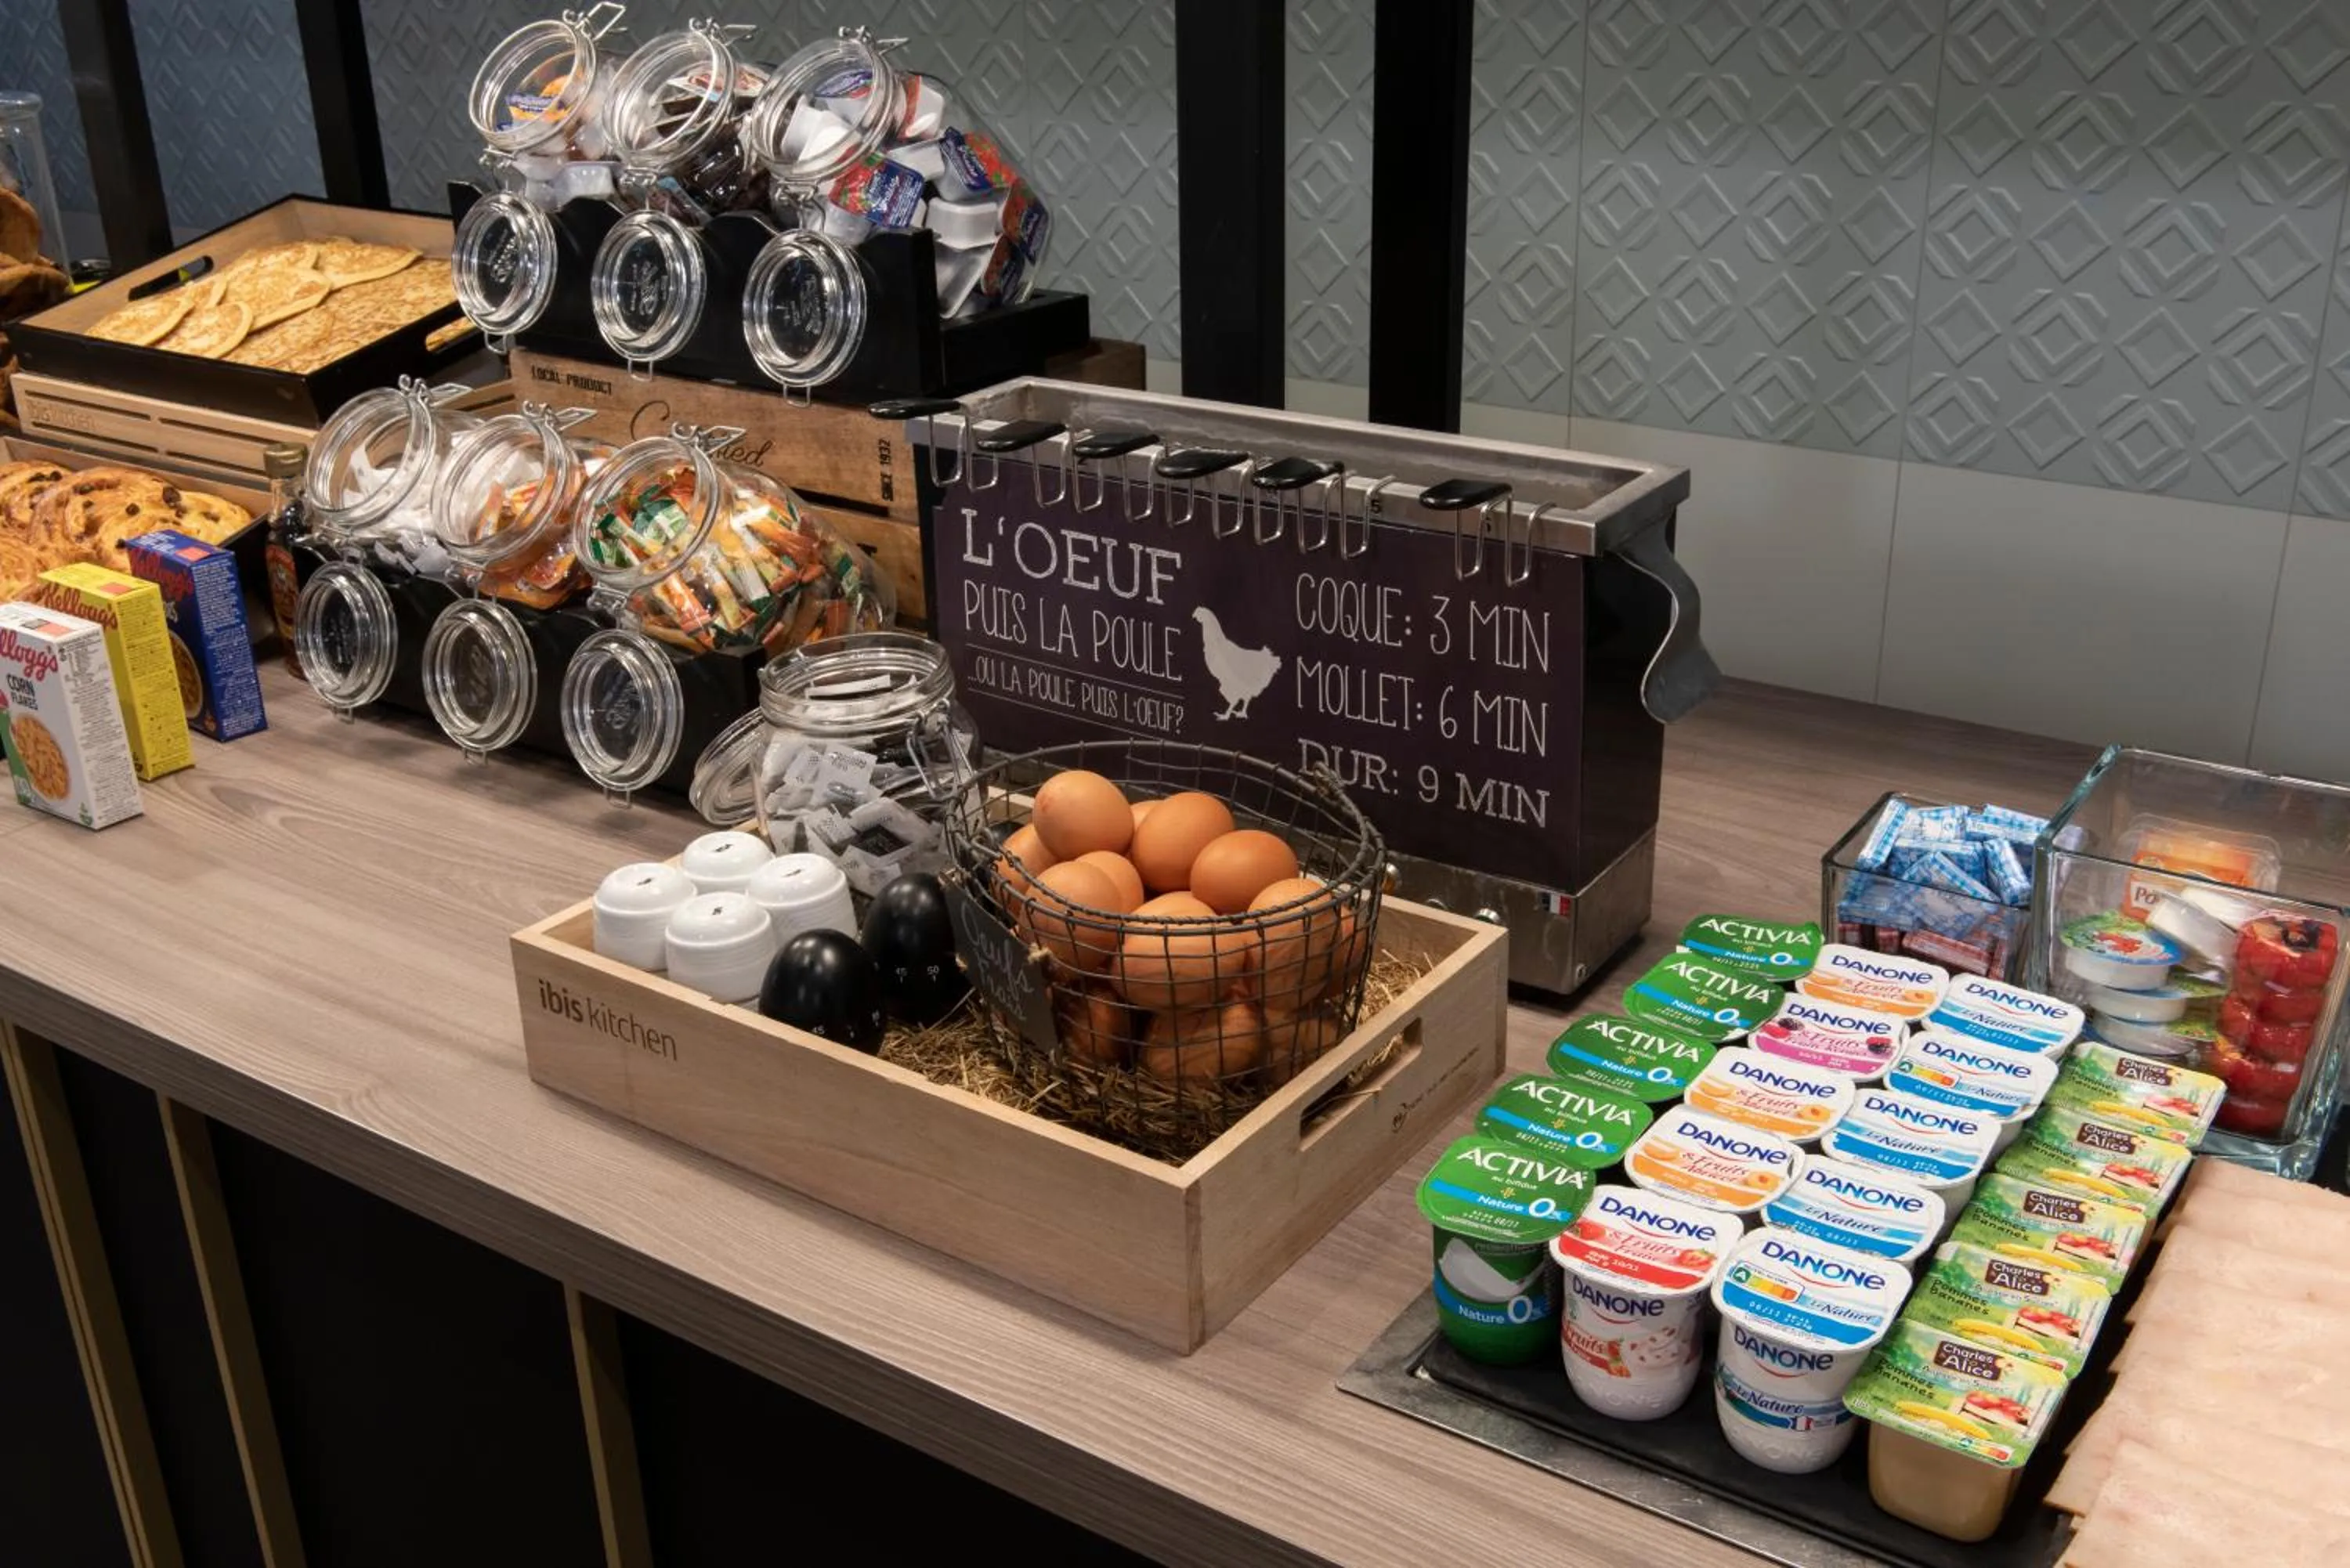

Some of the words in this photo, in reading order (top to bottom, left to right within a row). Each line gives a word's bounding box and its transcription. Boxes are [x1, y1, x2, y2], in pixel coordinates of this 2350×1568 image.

[961, 508, 1182, 605] L'OEUF
[964, 579, 1028, 645] PUIS
[1039, 597, 1079, 659] LA
[1093, 609, 1183, 682] POULE
[1296, 573, 1412, 648] COQUE:
[1430, 594, 1450, 655] 3
[1469, 600, 1550, 674] MIN
[1000, 661, 1023, 695] LA
[1028, 667, 1076, 708] POULE
[1081, 681, 1118, 719] PUIS
[1123, 692, 1184, 735] L'OEUF?
[1296, 655, 1423, 731] MOLLET:
[1439, 685, 1458, 739] 6
[1473, 689, 1549, 758] MIN
[1297, 737, 1400, 796] DUR:
[1417, 764, 1440, 804] 9
[1455, 771, 1550, 829] MIN
[1698, 918, 1811, 945] ACTIVIA
[1663, 961, 1772, 1004] ACTIVIA
[538, 978, 584, 1023] ibis
[587, 996, 678, 1062] kitchen
[1585, 1020, 1700, 1063] ACTIVIA
[1511, 1080, 1632, 1125] ACTIVIA
[1456, 1147, 1584, 1190] ACTIVIA
[2030, 1193, 2078, 1209] Charles
[2031, 1204, 2079, 1221] Alice
[1992, 1261, 2042, 1280] Charles
[1993, 1273, 2044, 1294] Alice
[1459, 1303, 1506, 1324] Nature
[1942, 1342, 1994, 1364] Charles
[1942, 1355, 1994, 1379] Alice
[1746, 1390, 1805, 1414] Nature
